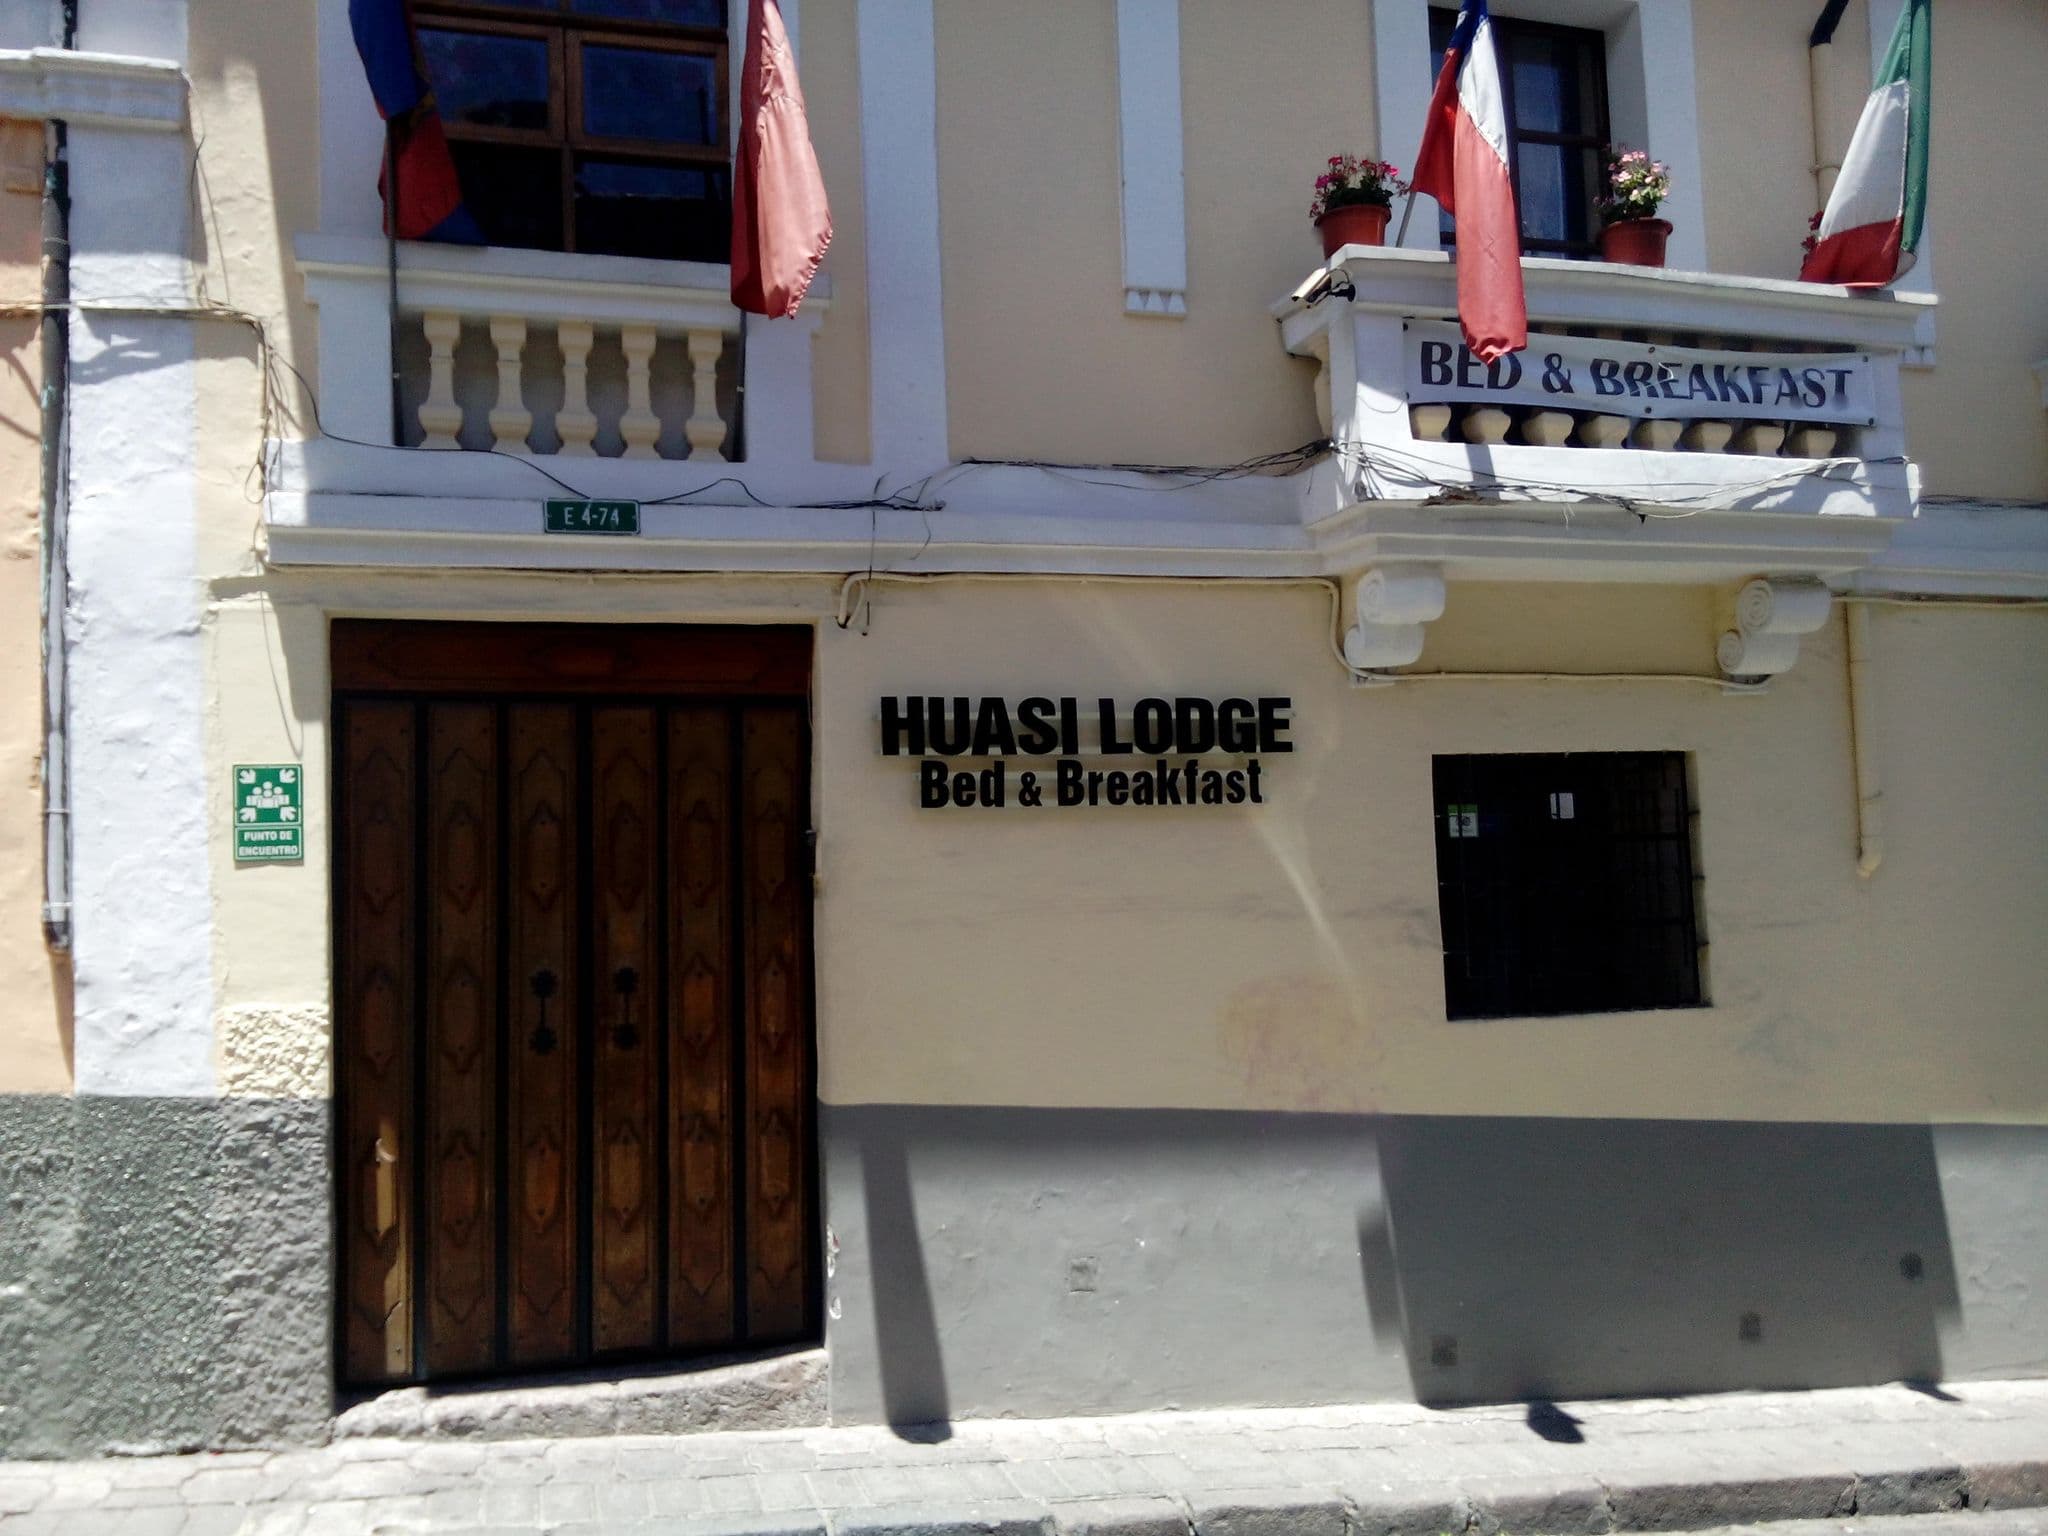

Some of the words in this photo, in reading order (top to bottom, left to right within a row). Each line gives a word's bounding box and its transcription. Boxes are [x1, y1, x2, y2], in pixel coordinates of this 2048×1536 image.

[1420, 340, 1523, 391] BED
[1542, 353, 1574, 394] &
[1590, 358, 1855, 409] BREAKFAST
[564, 507, 574, 525] E
[581, 504, 620, 526] 4-74
[881, 696, 1079, 756] HUASI
[1099, 697, 1294, 755] LODGE
[921, 760, 1005, 808] Bed
[1018, 772, 1042, 806] &
[1057, 759, 1262, 806] Breakfast
[239, 846, 298, 856] ENCUENTRO
[244, 831, 278, 841] PUNTO
[279, 831, 293, 840] DE
